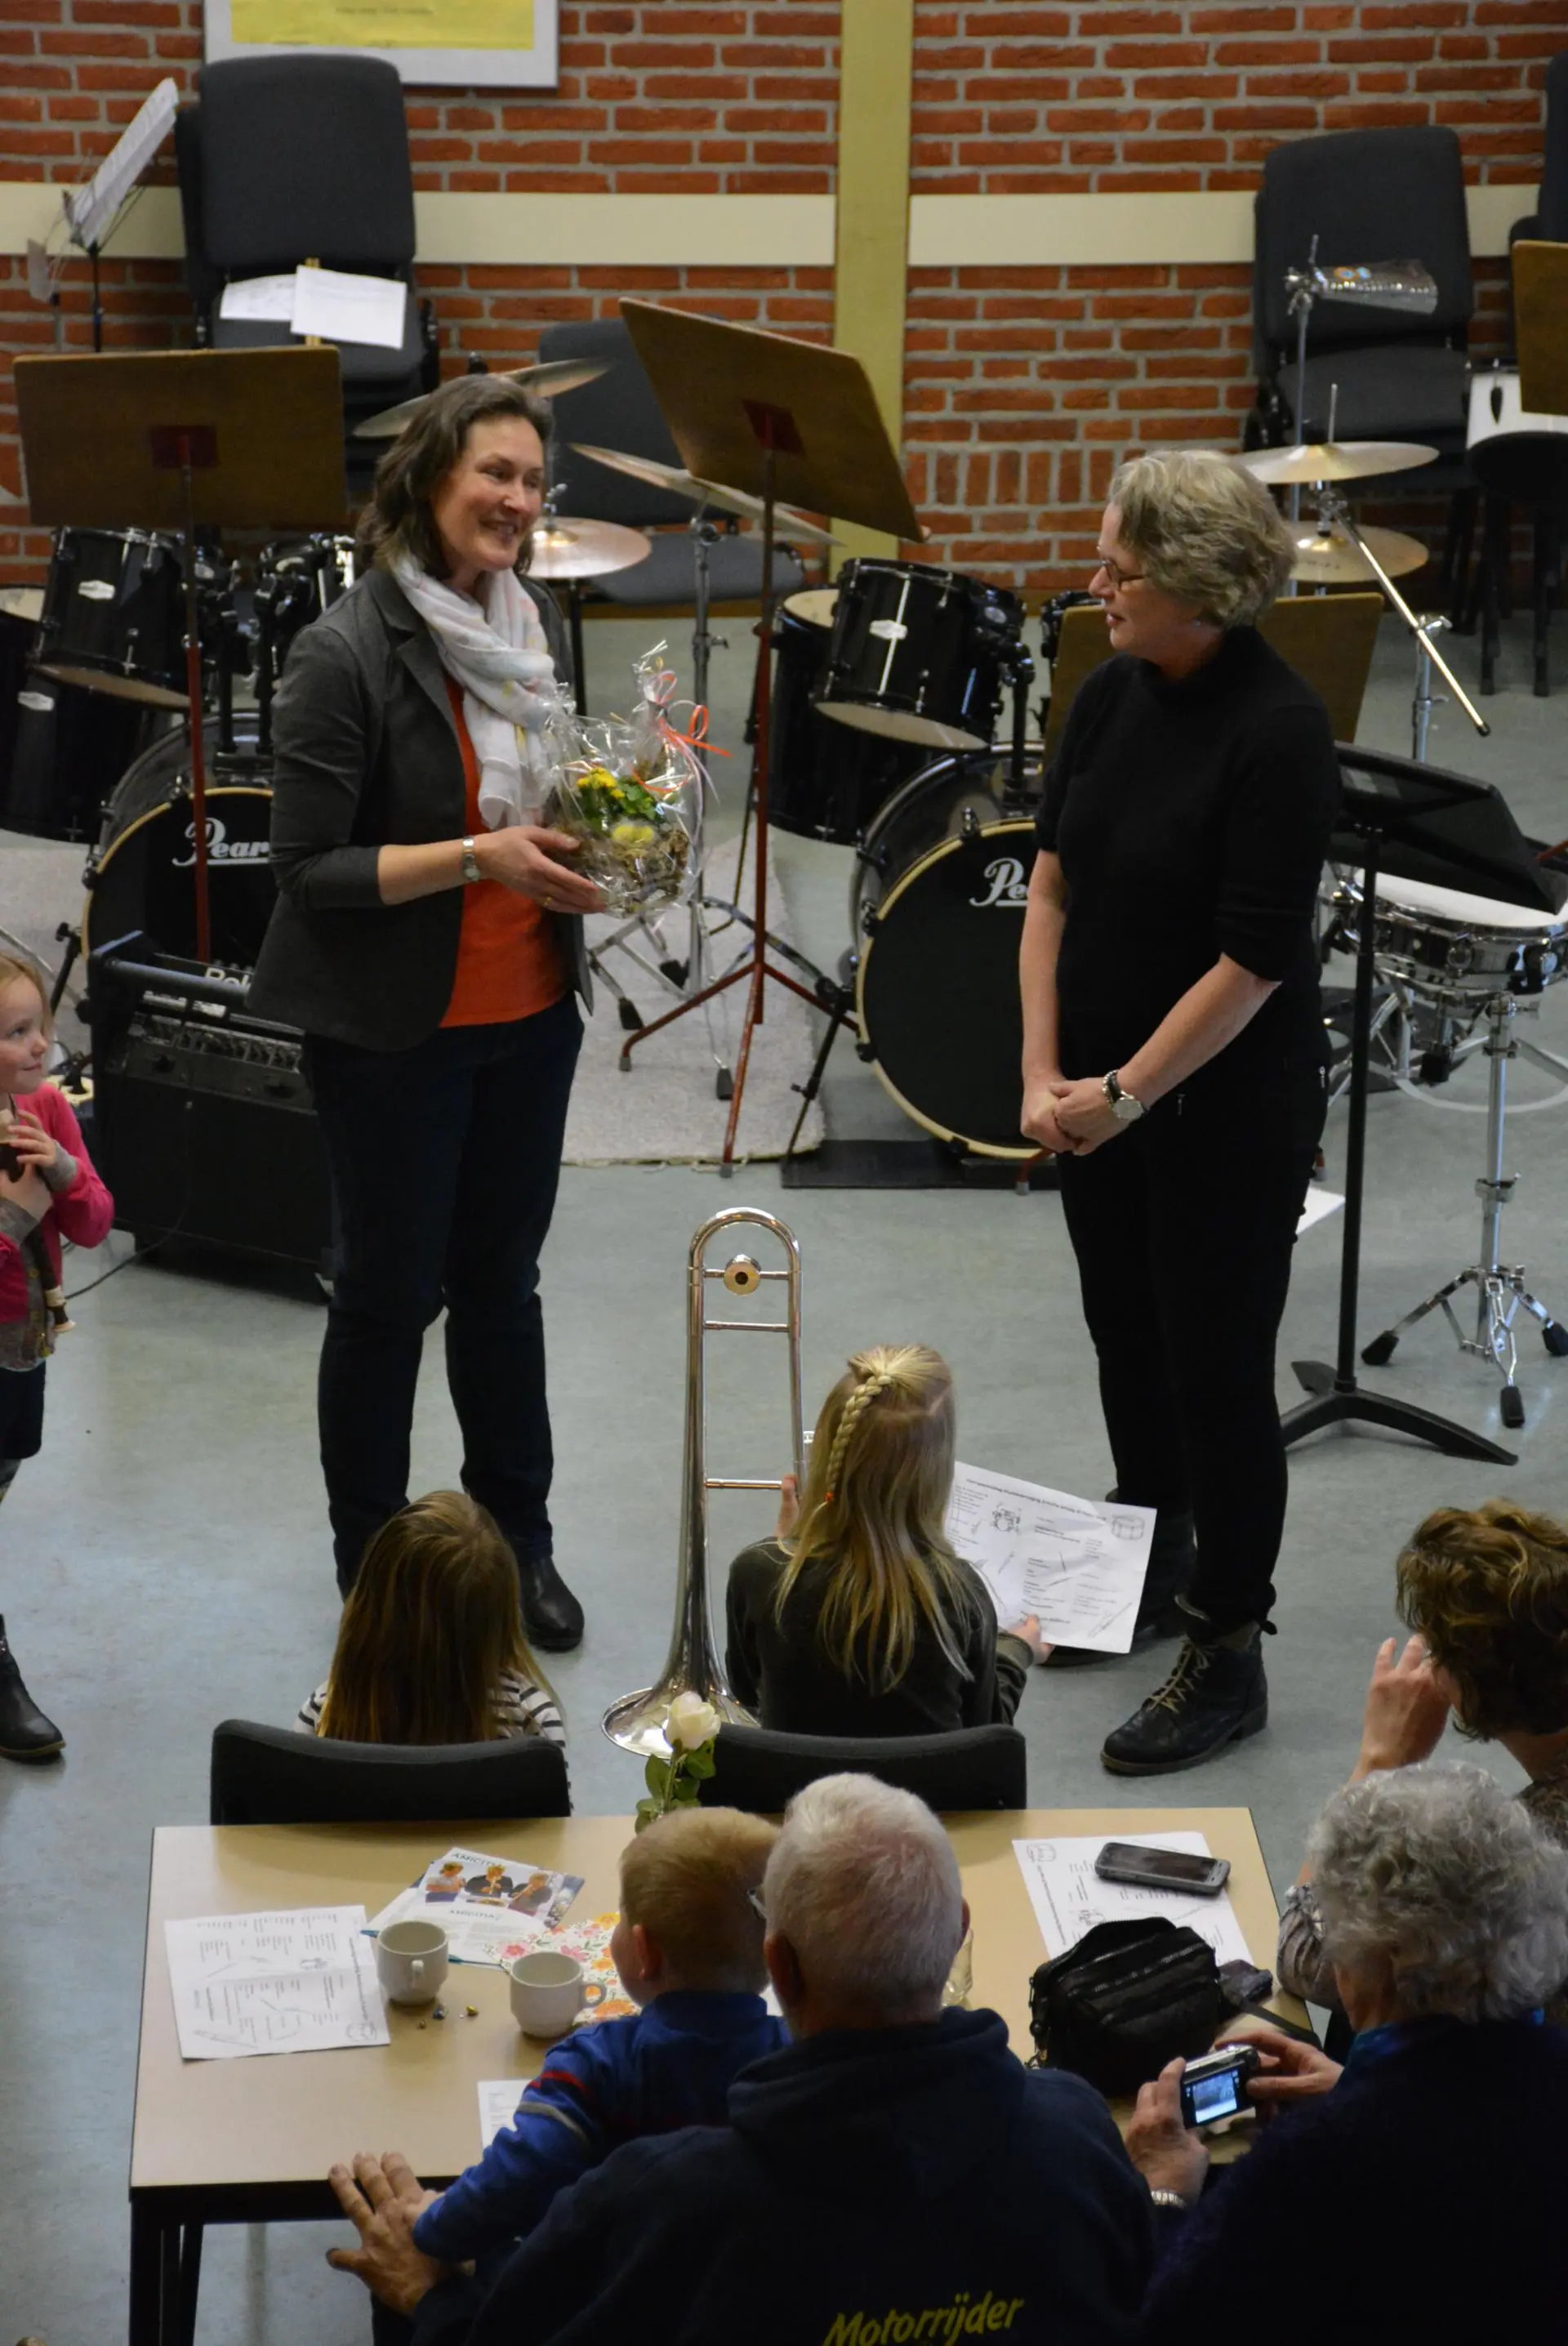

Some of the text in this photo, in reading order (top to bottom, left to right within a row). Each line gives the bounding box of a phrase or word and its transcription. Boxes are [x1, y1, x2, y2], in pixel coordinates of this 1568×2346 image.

[172, 817, 270, 866] Pear
[969, 857, 1028, 907] Pe
[822, 2290, 1025, 2346] Motorrijder
